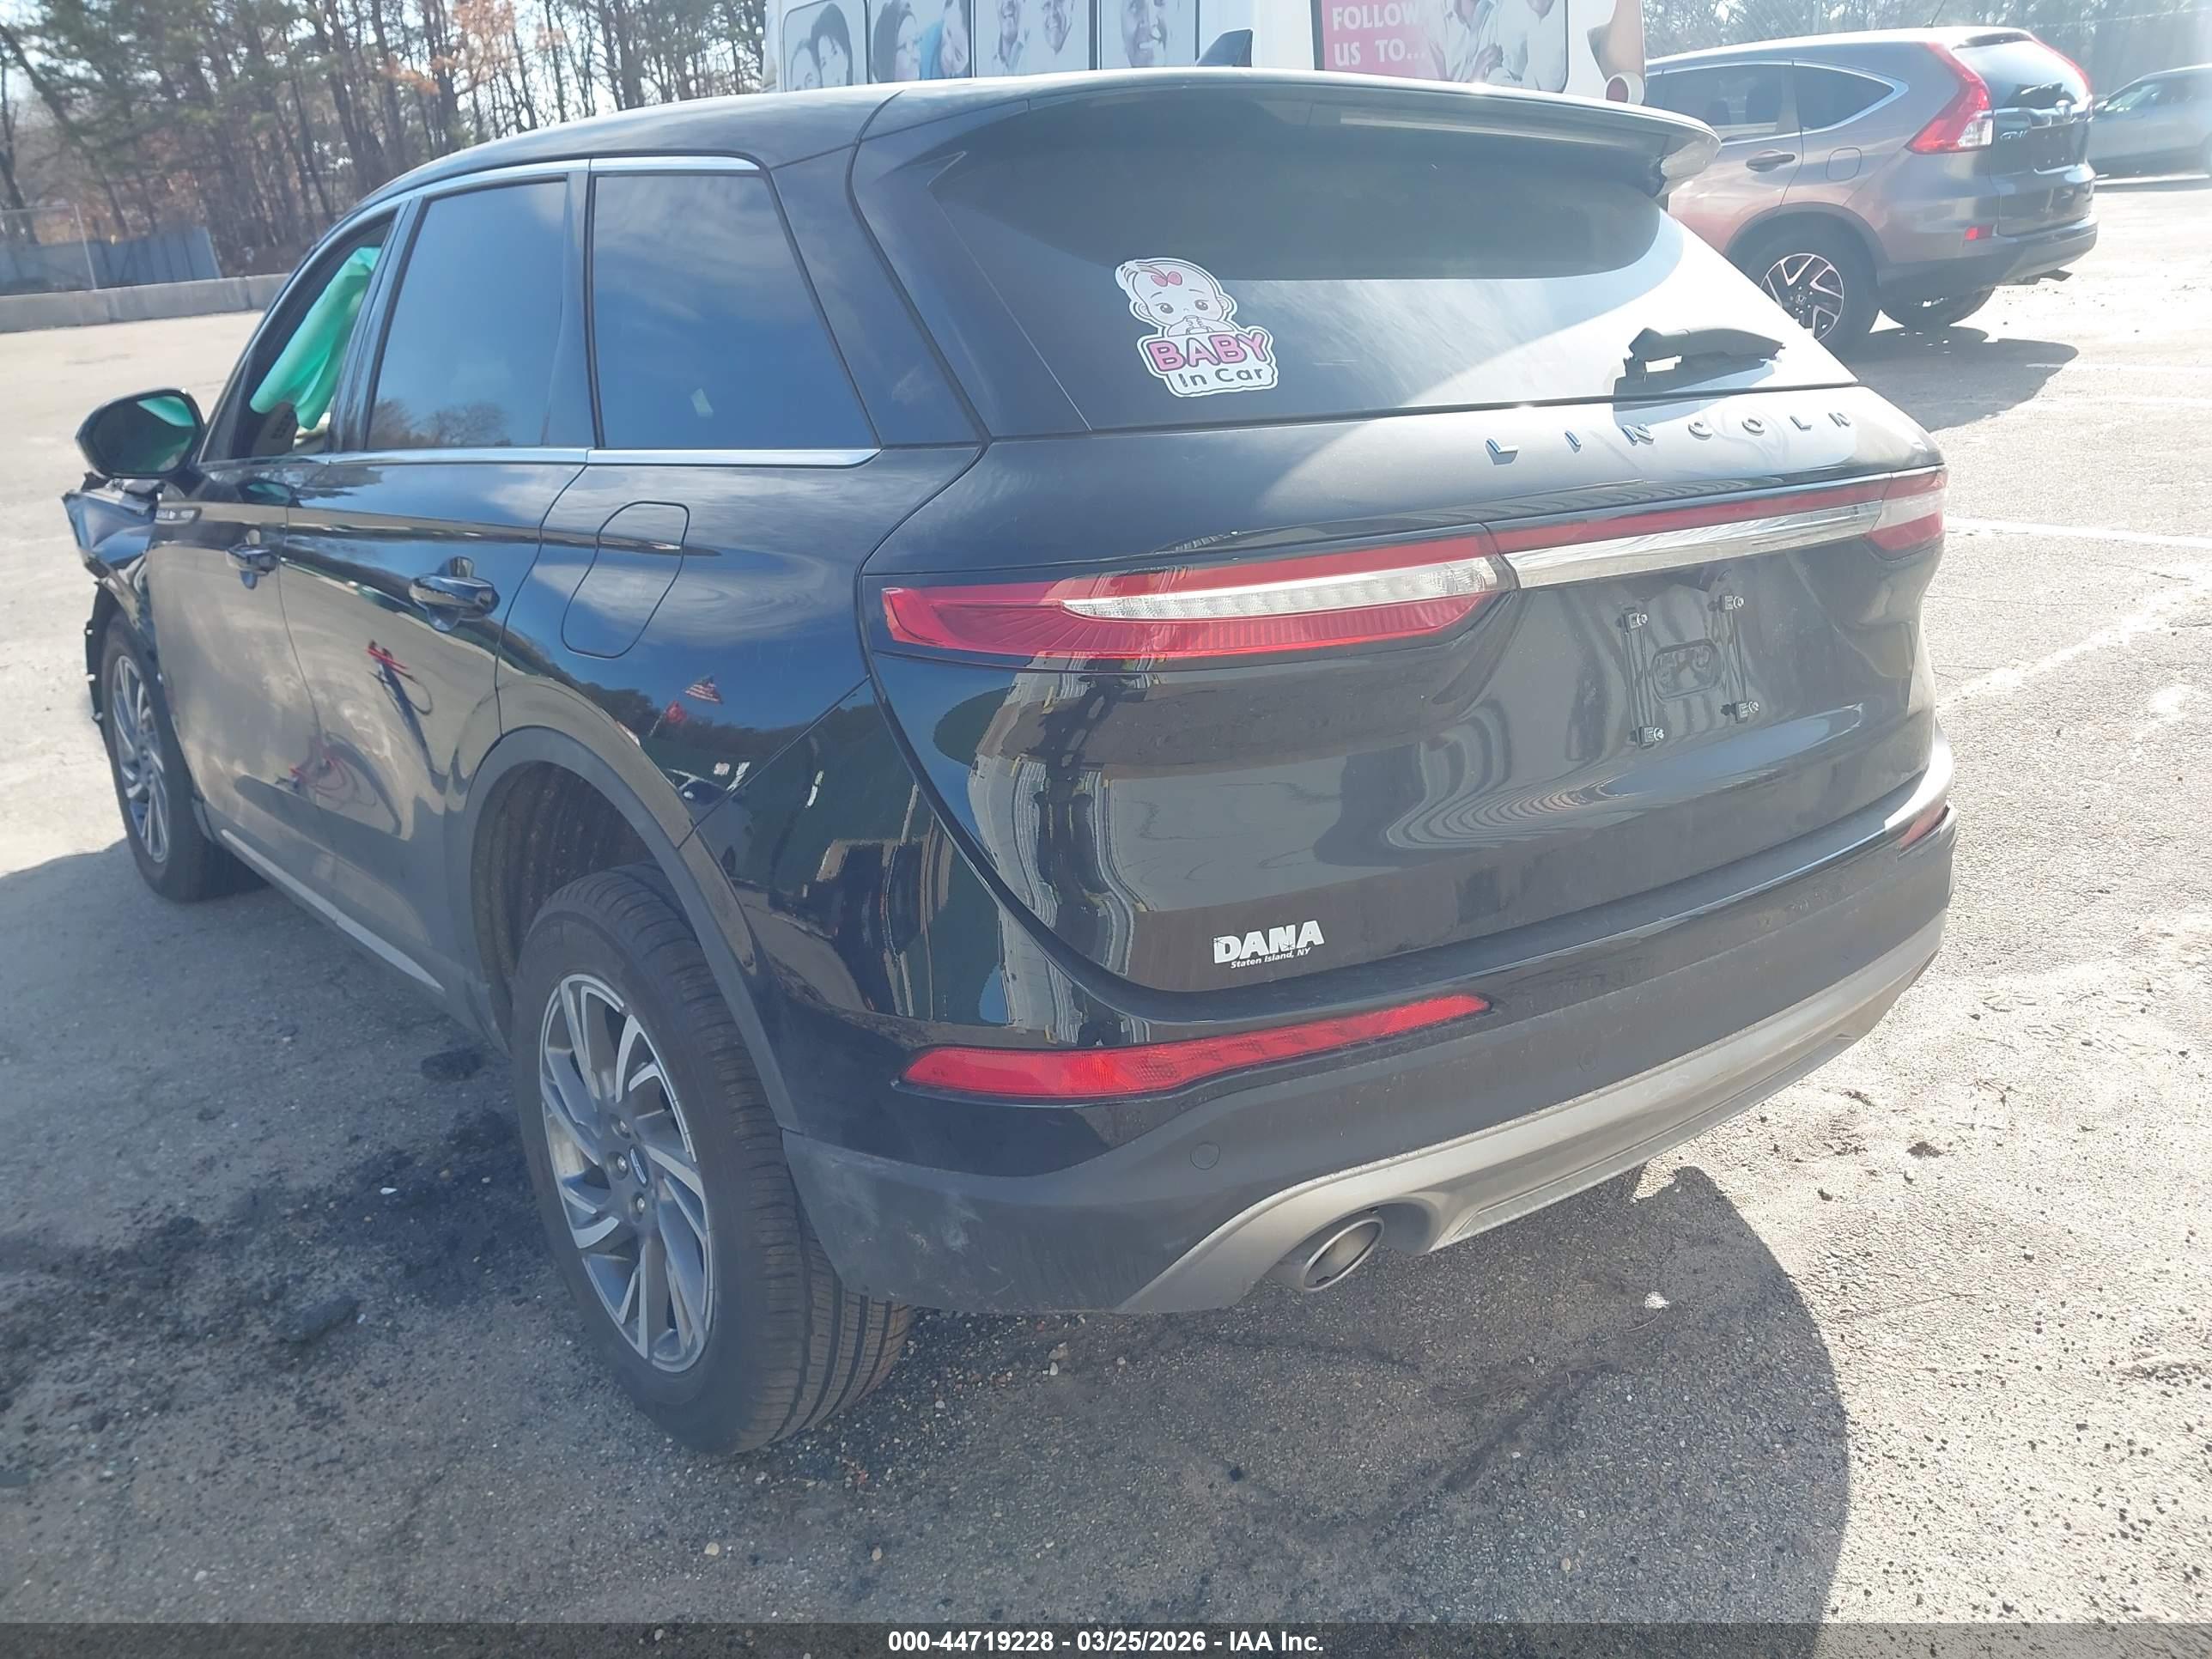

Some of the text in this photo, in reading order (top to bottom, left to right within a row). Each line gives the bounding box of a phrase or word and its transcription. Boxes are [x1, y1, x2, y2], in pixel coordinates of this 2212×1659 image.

[1332, 3, 1419, 31] FOLLOW
[1334, 41, 1362, 67] US
[1146, 332, 1267, 372] BABY
[1177, 367, 1264, 388] In Car
[1485, 410, 1852, 465] LINCOLN
[1213, 919, 1325, 964] DANA
[1230, 946, 1311, 969] Staten Island, NY
